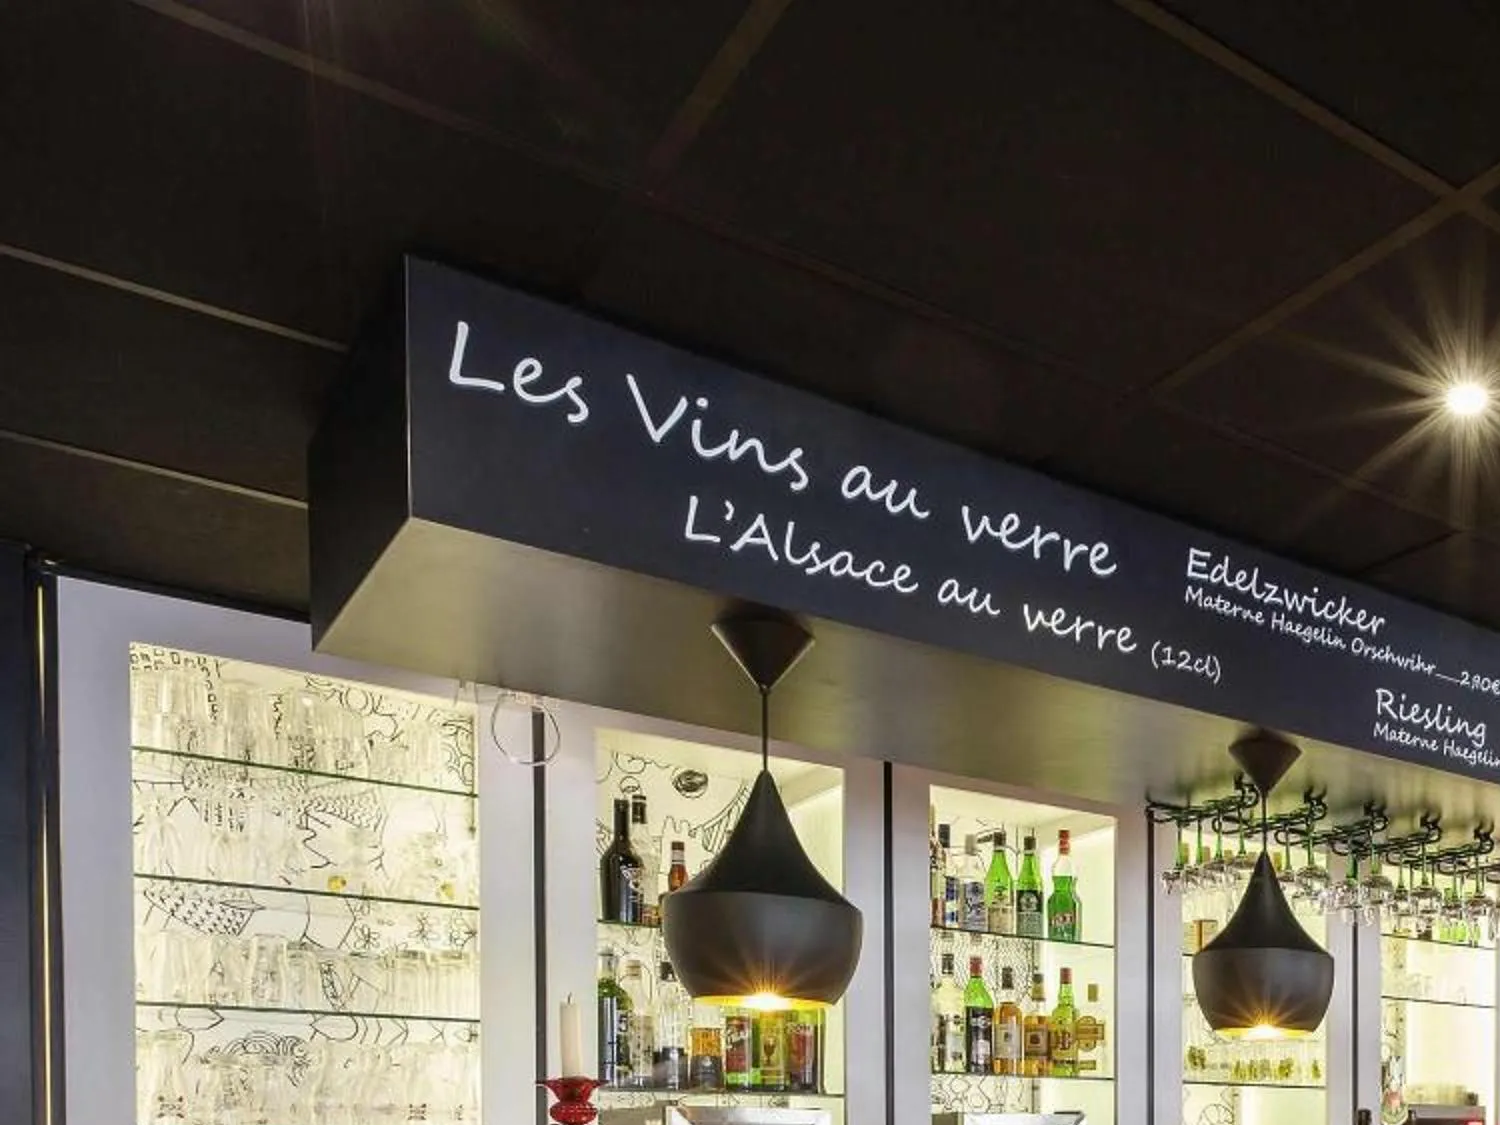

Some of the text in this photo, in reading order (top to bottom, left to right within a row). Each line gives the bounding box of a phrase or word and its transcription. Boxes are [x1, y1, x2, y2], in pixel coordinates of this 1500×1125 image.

[449, 321, 1118, 577] Les Vins au verre
[684, 495, 1221, 684] L'Alsace au verre (12cl)
[1185, 585, 1264, 625] Materne
[1271, 611, 1347, 649] Haegelin
[1351, 637, 1436, 676] Orschwihr
[1186, 547, 1386, 635] Edelzwicker
[1373, 722, 1438, 751] Materne
[1375, 688, 1486, 748] Riesling
